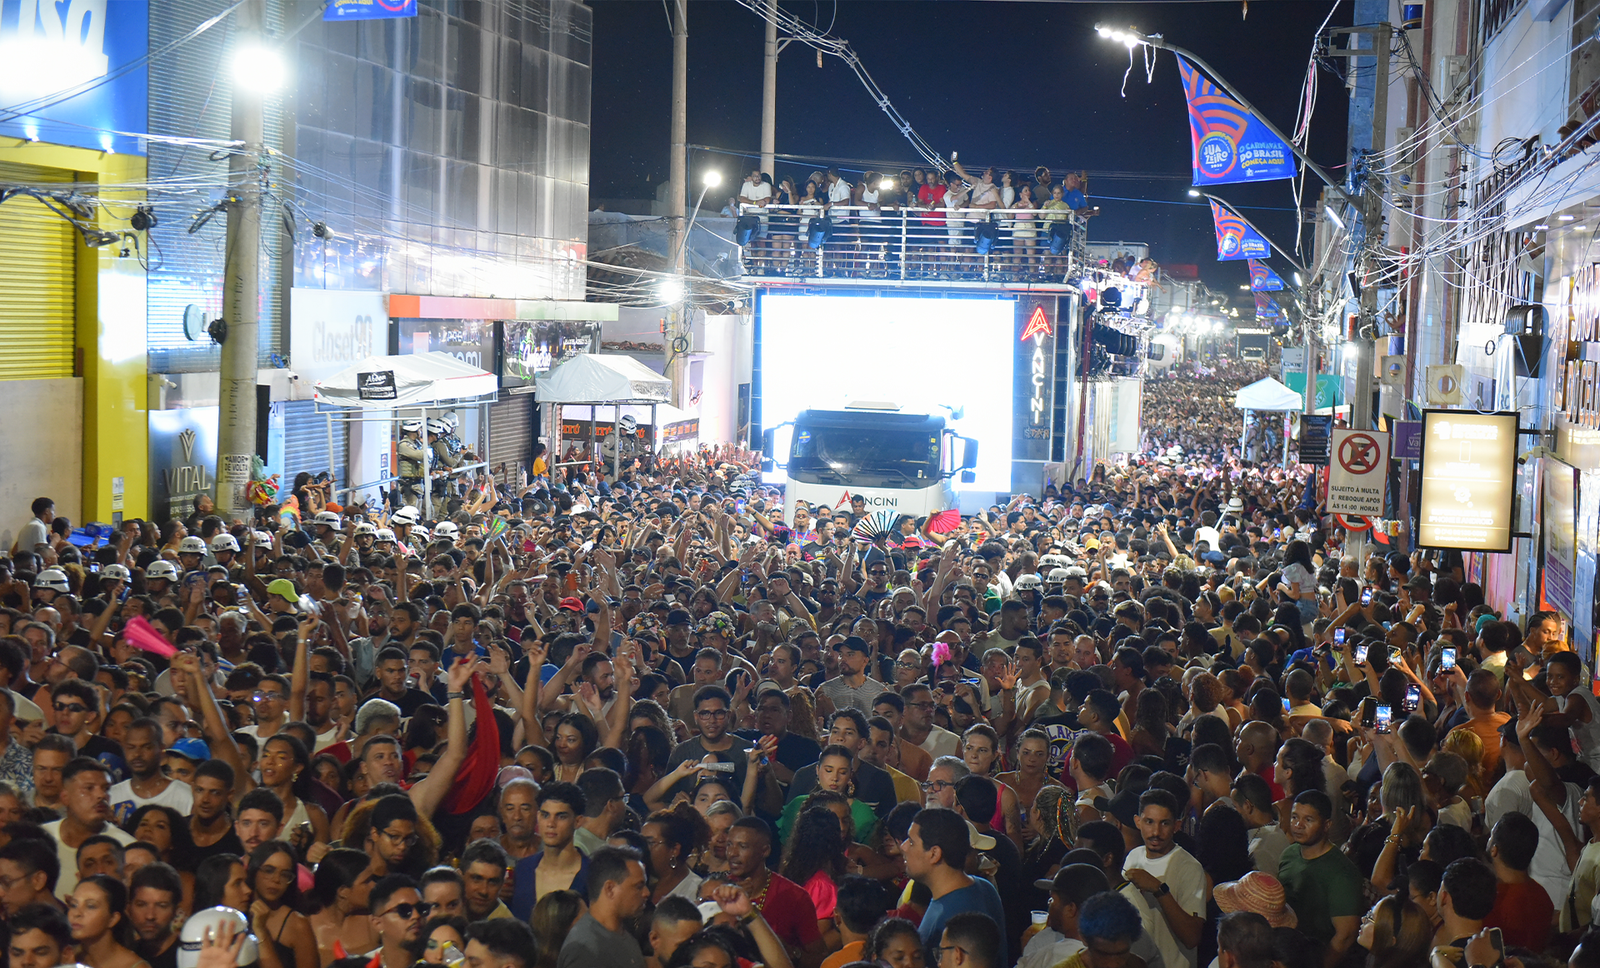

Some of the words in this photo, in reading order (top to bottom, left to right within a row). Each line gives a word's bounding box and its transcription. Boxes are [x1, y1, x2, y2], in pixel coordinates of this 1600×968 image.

[1240, 150, 1252, 163] DO
[1253, 150, 1284, 158] BRASIL
[1242, 158, 1268, 168] COMEÇA
[162, 465, 211, 494] VITAL
